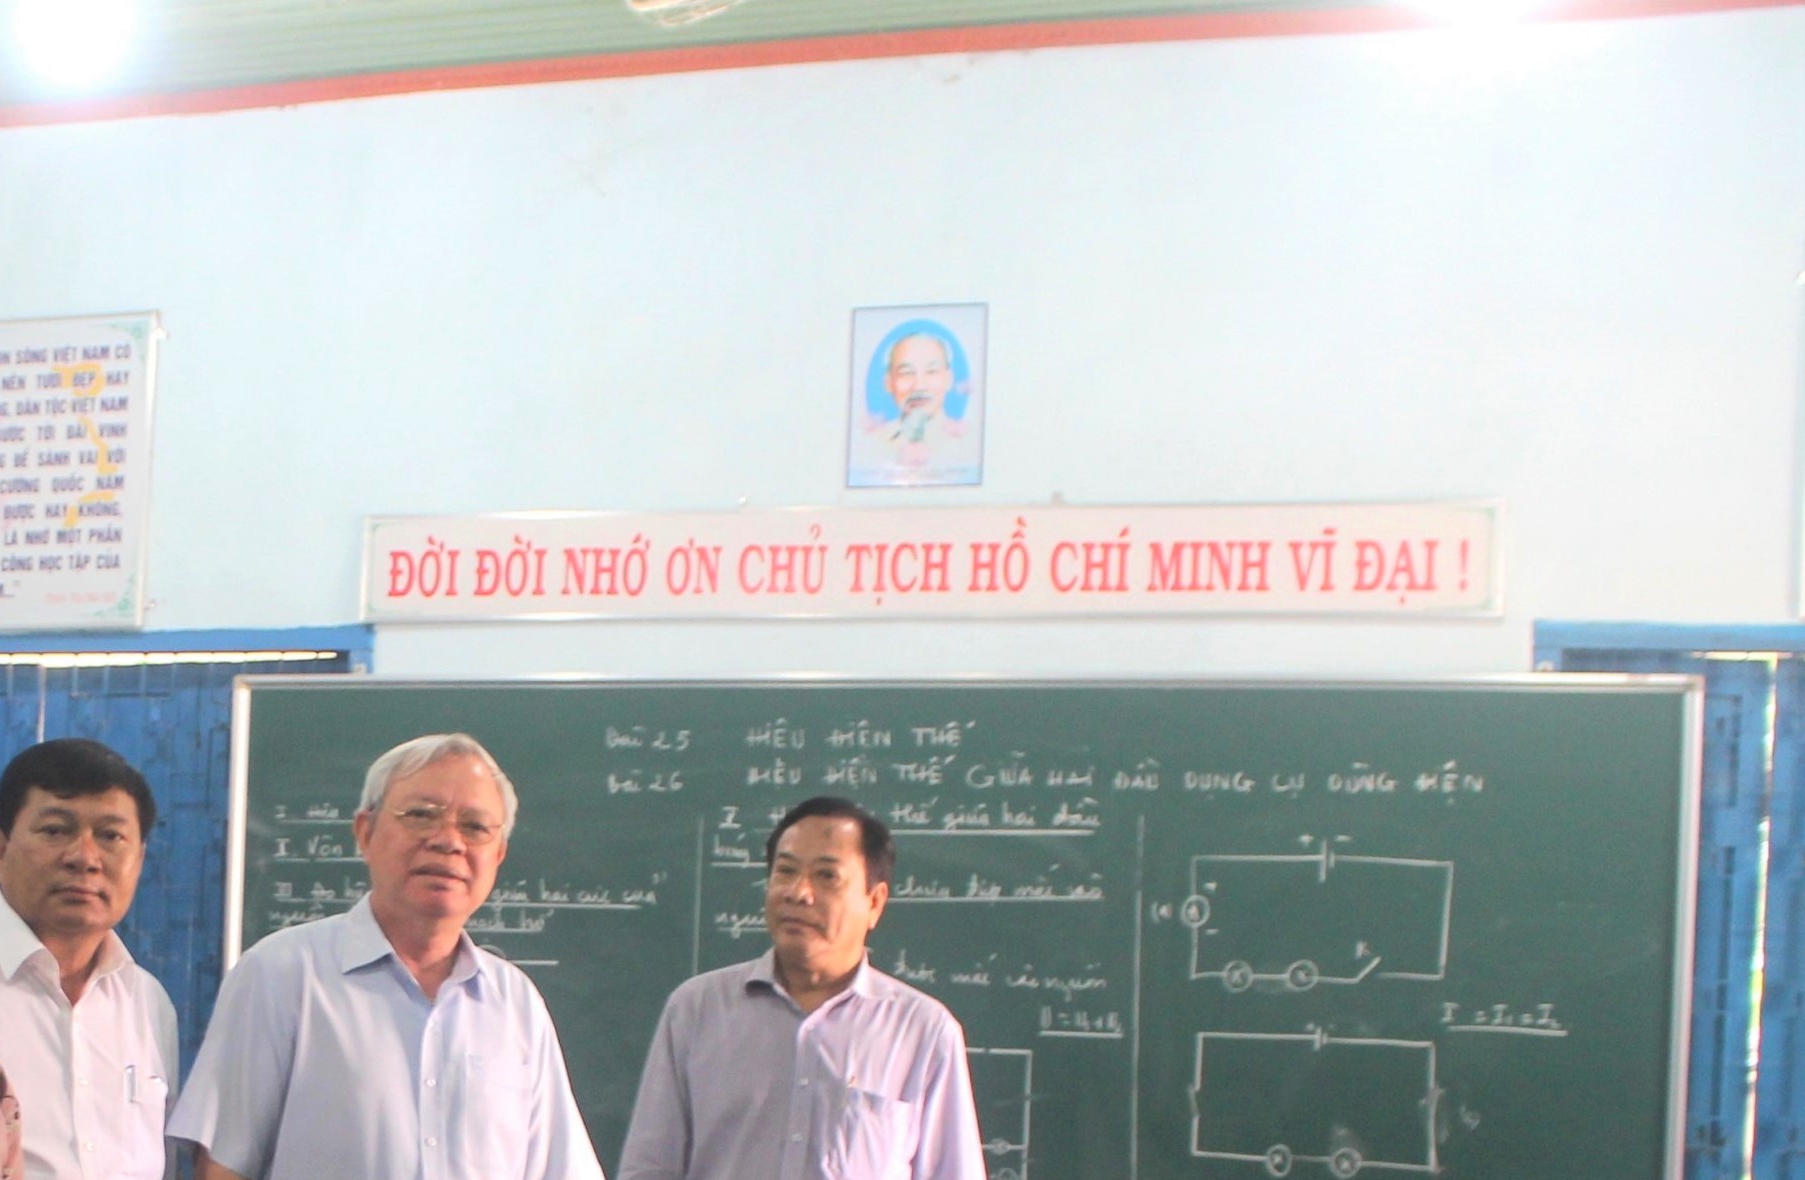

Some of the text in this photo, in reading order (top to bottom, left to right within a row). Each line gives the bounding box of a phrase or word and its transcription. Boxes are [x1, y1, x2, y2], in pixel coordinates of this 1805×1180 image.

[16, 345, 48, 364] SÔNG
[53, 346, 77, 363] VIỆT
[82, 344, 110, 360] NAM
[114, 343, 131, 360] CÓ
[1, 373, 26, 390] NÊN
[73, 371, 96, 388] ĐẸP
[106, 370, 130, 385] HAY
[16, 399, 40, 416] DÂN
[46, 398, 67, 415] TỘC
[72, 397, 96, 414] VIỆT
[100, 396, 128, 412] NAM
[99, 422, 127, 438] VINH
[38, 449, 70, 466] SÁNH
[79, 450, 98, 465] VAI
[107, 447, 126, 464] VỚI
[0, 476, 40, 494] CƯỜNG
[51, 474, 84, 493] QUỐC
[4, 504, 35, 522] ĐƯỢC
[44, 504, 68, 518] HAY
[4, 529, 18, 546] LÀ
[25, 529, 50, 544] NHỜ
[56, 528, 82, 546] MỘT
[89, 524, 122, 543] PHẦN
[1, 555, 33, 572] CÔNG
[39, 555, 62, 574] HỌC
[69, 554, 91, 572] TẬP
[96, 550, 120, 569] CỦA
[387, 515, 1471, 605] ĐỜI ĐỜI NHỚ ƠN CHỦ TỊCH HỒ CHÍ MINH VĨ ĐẠI !
[652, 729, 691, 751] 25
[911, 719, 976, 749] THẾ
[649, 772, 685, 793] 26
[892, 754, 956, 786] THẾ
[1271, 772, 1305, 799] CỤ
[1001, 801, 1036, 827] hai
